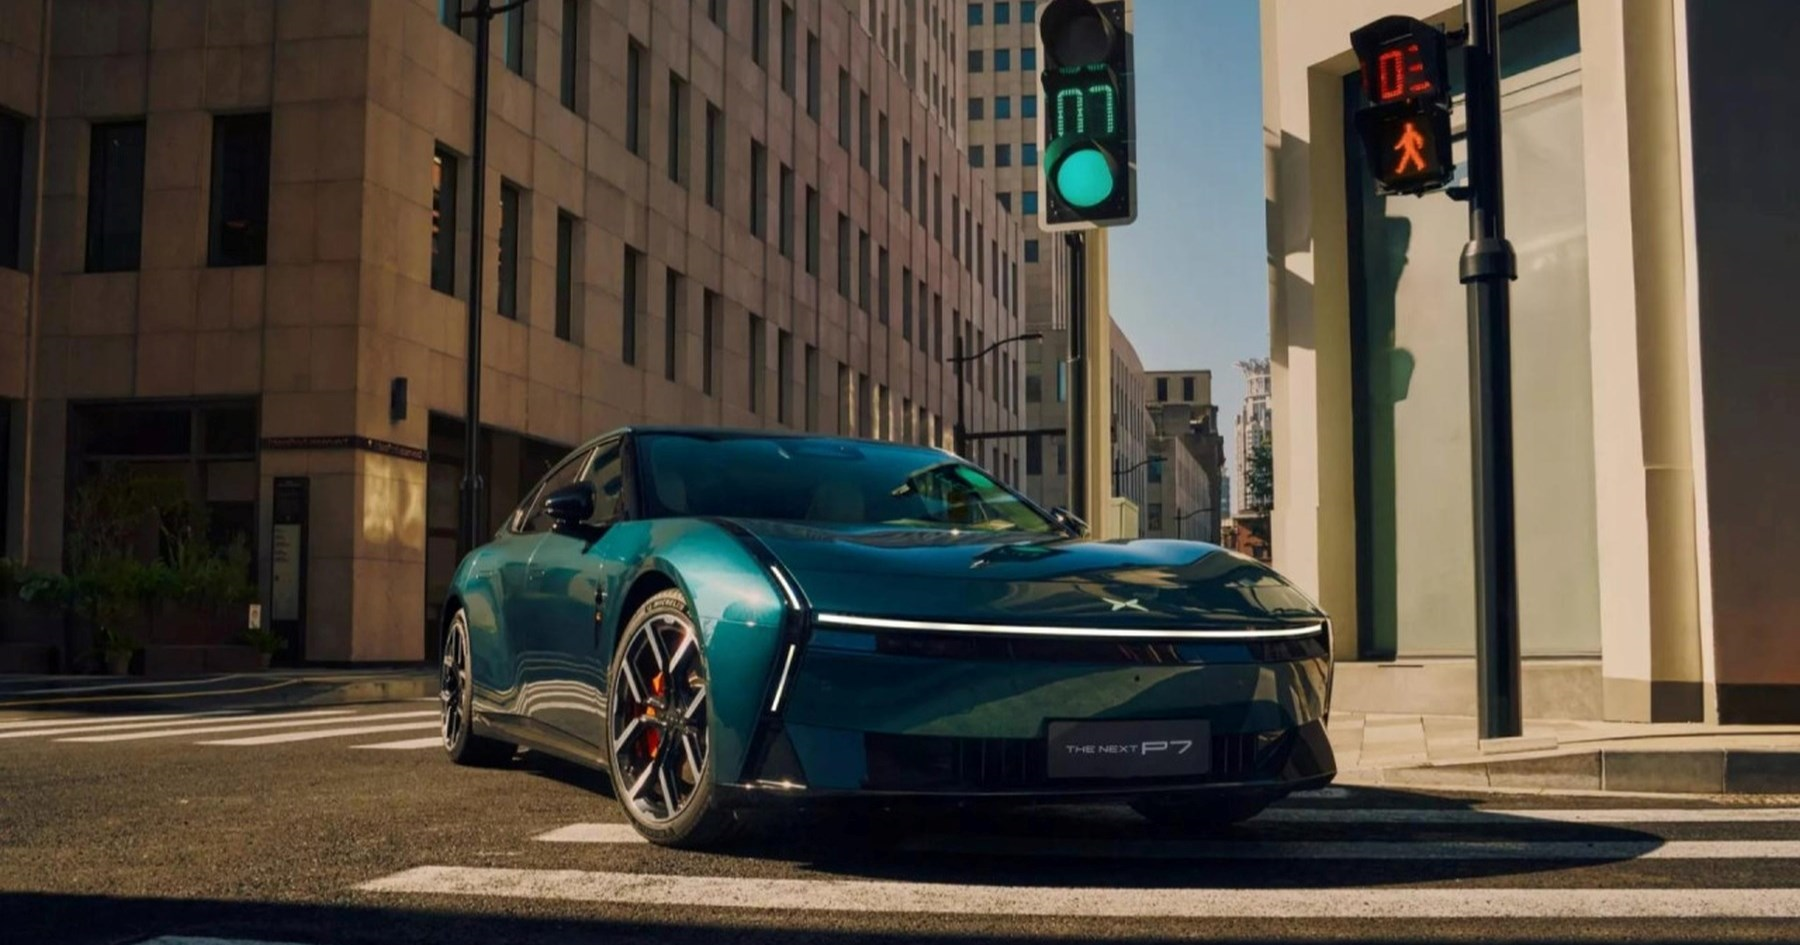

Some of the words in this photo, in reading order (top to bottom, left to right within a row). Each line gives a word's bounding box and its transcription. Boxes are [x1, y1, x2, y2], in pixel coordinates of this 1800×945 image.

[1066, 745, 1096, 754] THE
[1098, 744, 1139, 754] NEXT
[1141, 740, 1193, 756] P7
